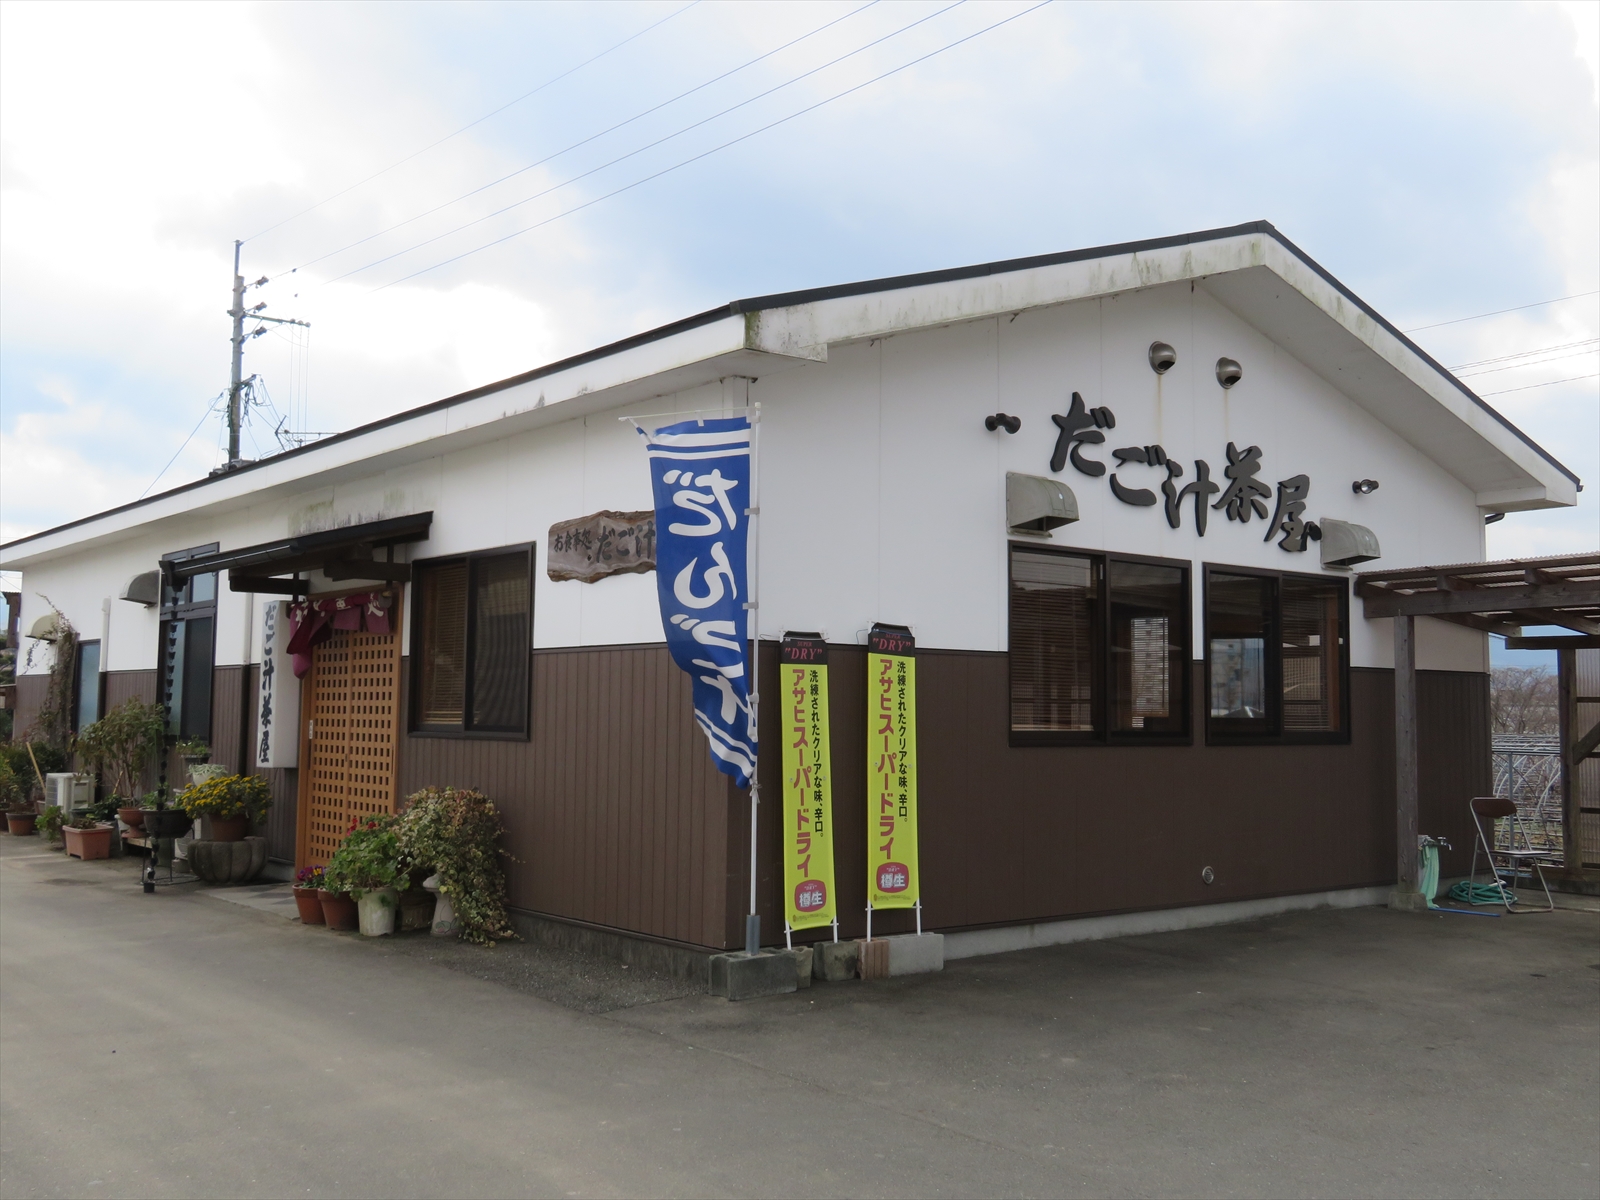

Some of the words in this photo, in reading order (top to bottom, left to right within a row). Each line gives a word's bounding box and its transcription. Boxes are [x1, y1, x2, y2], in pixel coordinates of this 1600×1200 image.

[553, 527, 592, 552] お食事処
[1050, 391, 1312, 552] だご汁茶屋
[259, 604, 278, 763] だご汁茶屋
[810, 670, 823, 838] 洗練されたクリアな味、辛口。
[878, 659, 897, 860] アサヒスーパードライ
[897, 661, 907, 822] 洗練されたクリアな味、辛口。
[792, 669, 812, 878] アサヒスーパードライ
[799, 890, 823, 908] 樽生
[880, 872, 905, 888] 樽生
